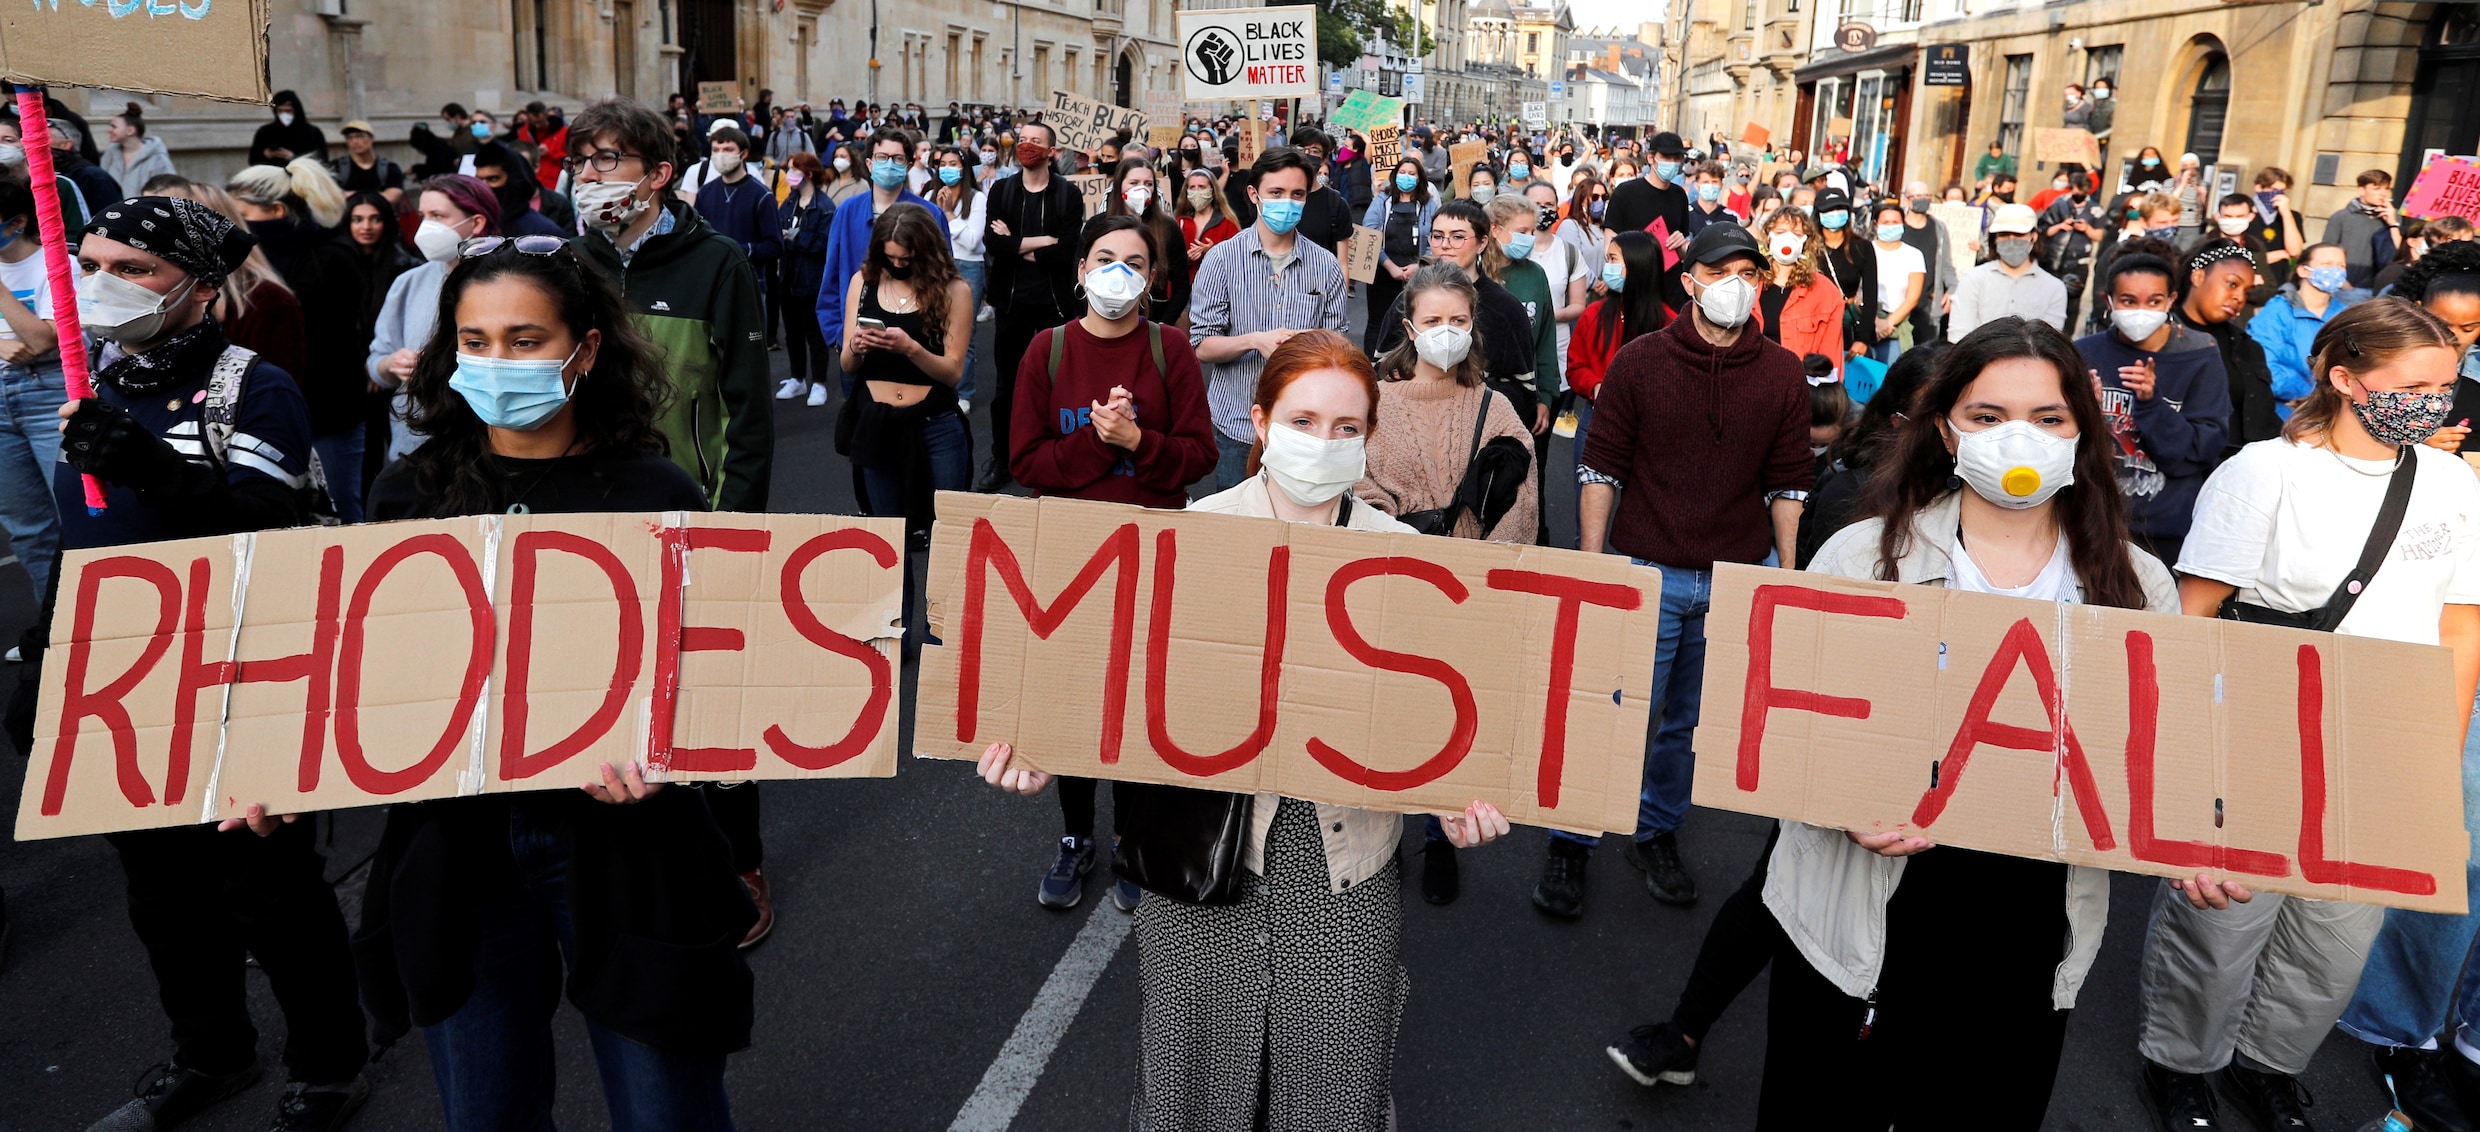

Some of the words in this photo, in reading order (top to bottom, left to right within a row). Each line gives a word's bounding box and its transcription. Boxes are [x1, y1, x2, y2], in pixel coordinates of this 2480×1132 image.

[1246, 21, 1304, 40] BLACK
[1247, 43, 1305, 61] LIVES
[1248, 65, 1306, 85] MATTER
[1044, 109, 1085, 128] HISTORY
[1088, 124, 1101, 135] IN
[1053, 91, 1091, 116] TEACH
[1093, 104, 1147, 140] BLACK
[1057, 126, 1104, 151] SCHO
[1371, 126, 1399, 141] RHODES
[1375, 143, 1398, 154] MUST
[2443, 185, 2480, 205] LIVES
[2403, 523, 2433, 540] THE
[41, 528, 898, 816] RHODES
[956, 517, 1642, 809] MUST
[1736, 585, 2437, 895] FALL
